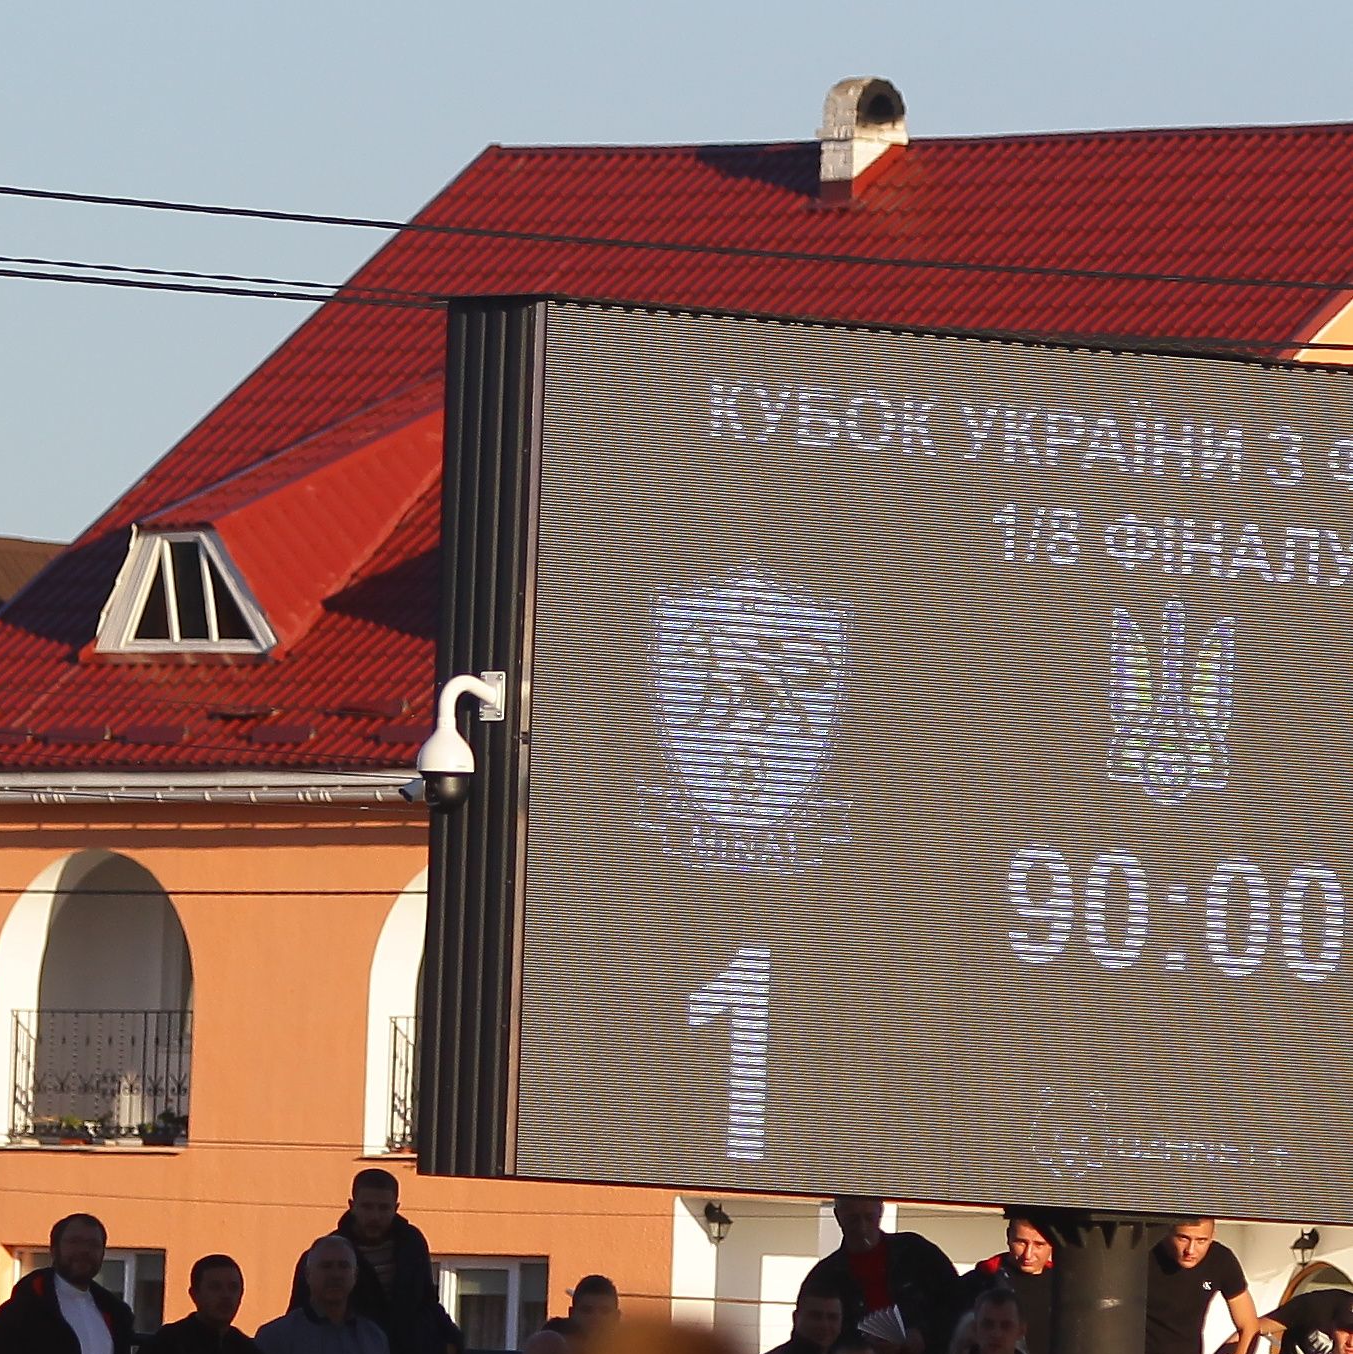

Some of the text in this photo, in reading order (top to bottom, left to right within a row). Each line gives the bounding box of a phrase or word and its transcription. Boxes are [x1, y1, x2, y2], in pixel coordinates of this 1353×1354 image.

[710, 378, 940, 457] КУБОК
[960, 400, 1245, 483] УКРАЇНИ
[991, 501, 1353, 588] 1/8 ФІНАЛУ
[1007, 843, 1345, 985] 90:00
[687, 942, 772, 1162] 1
